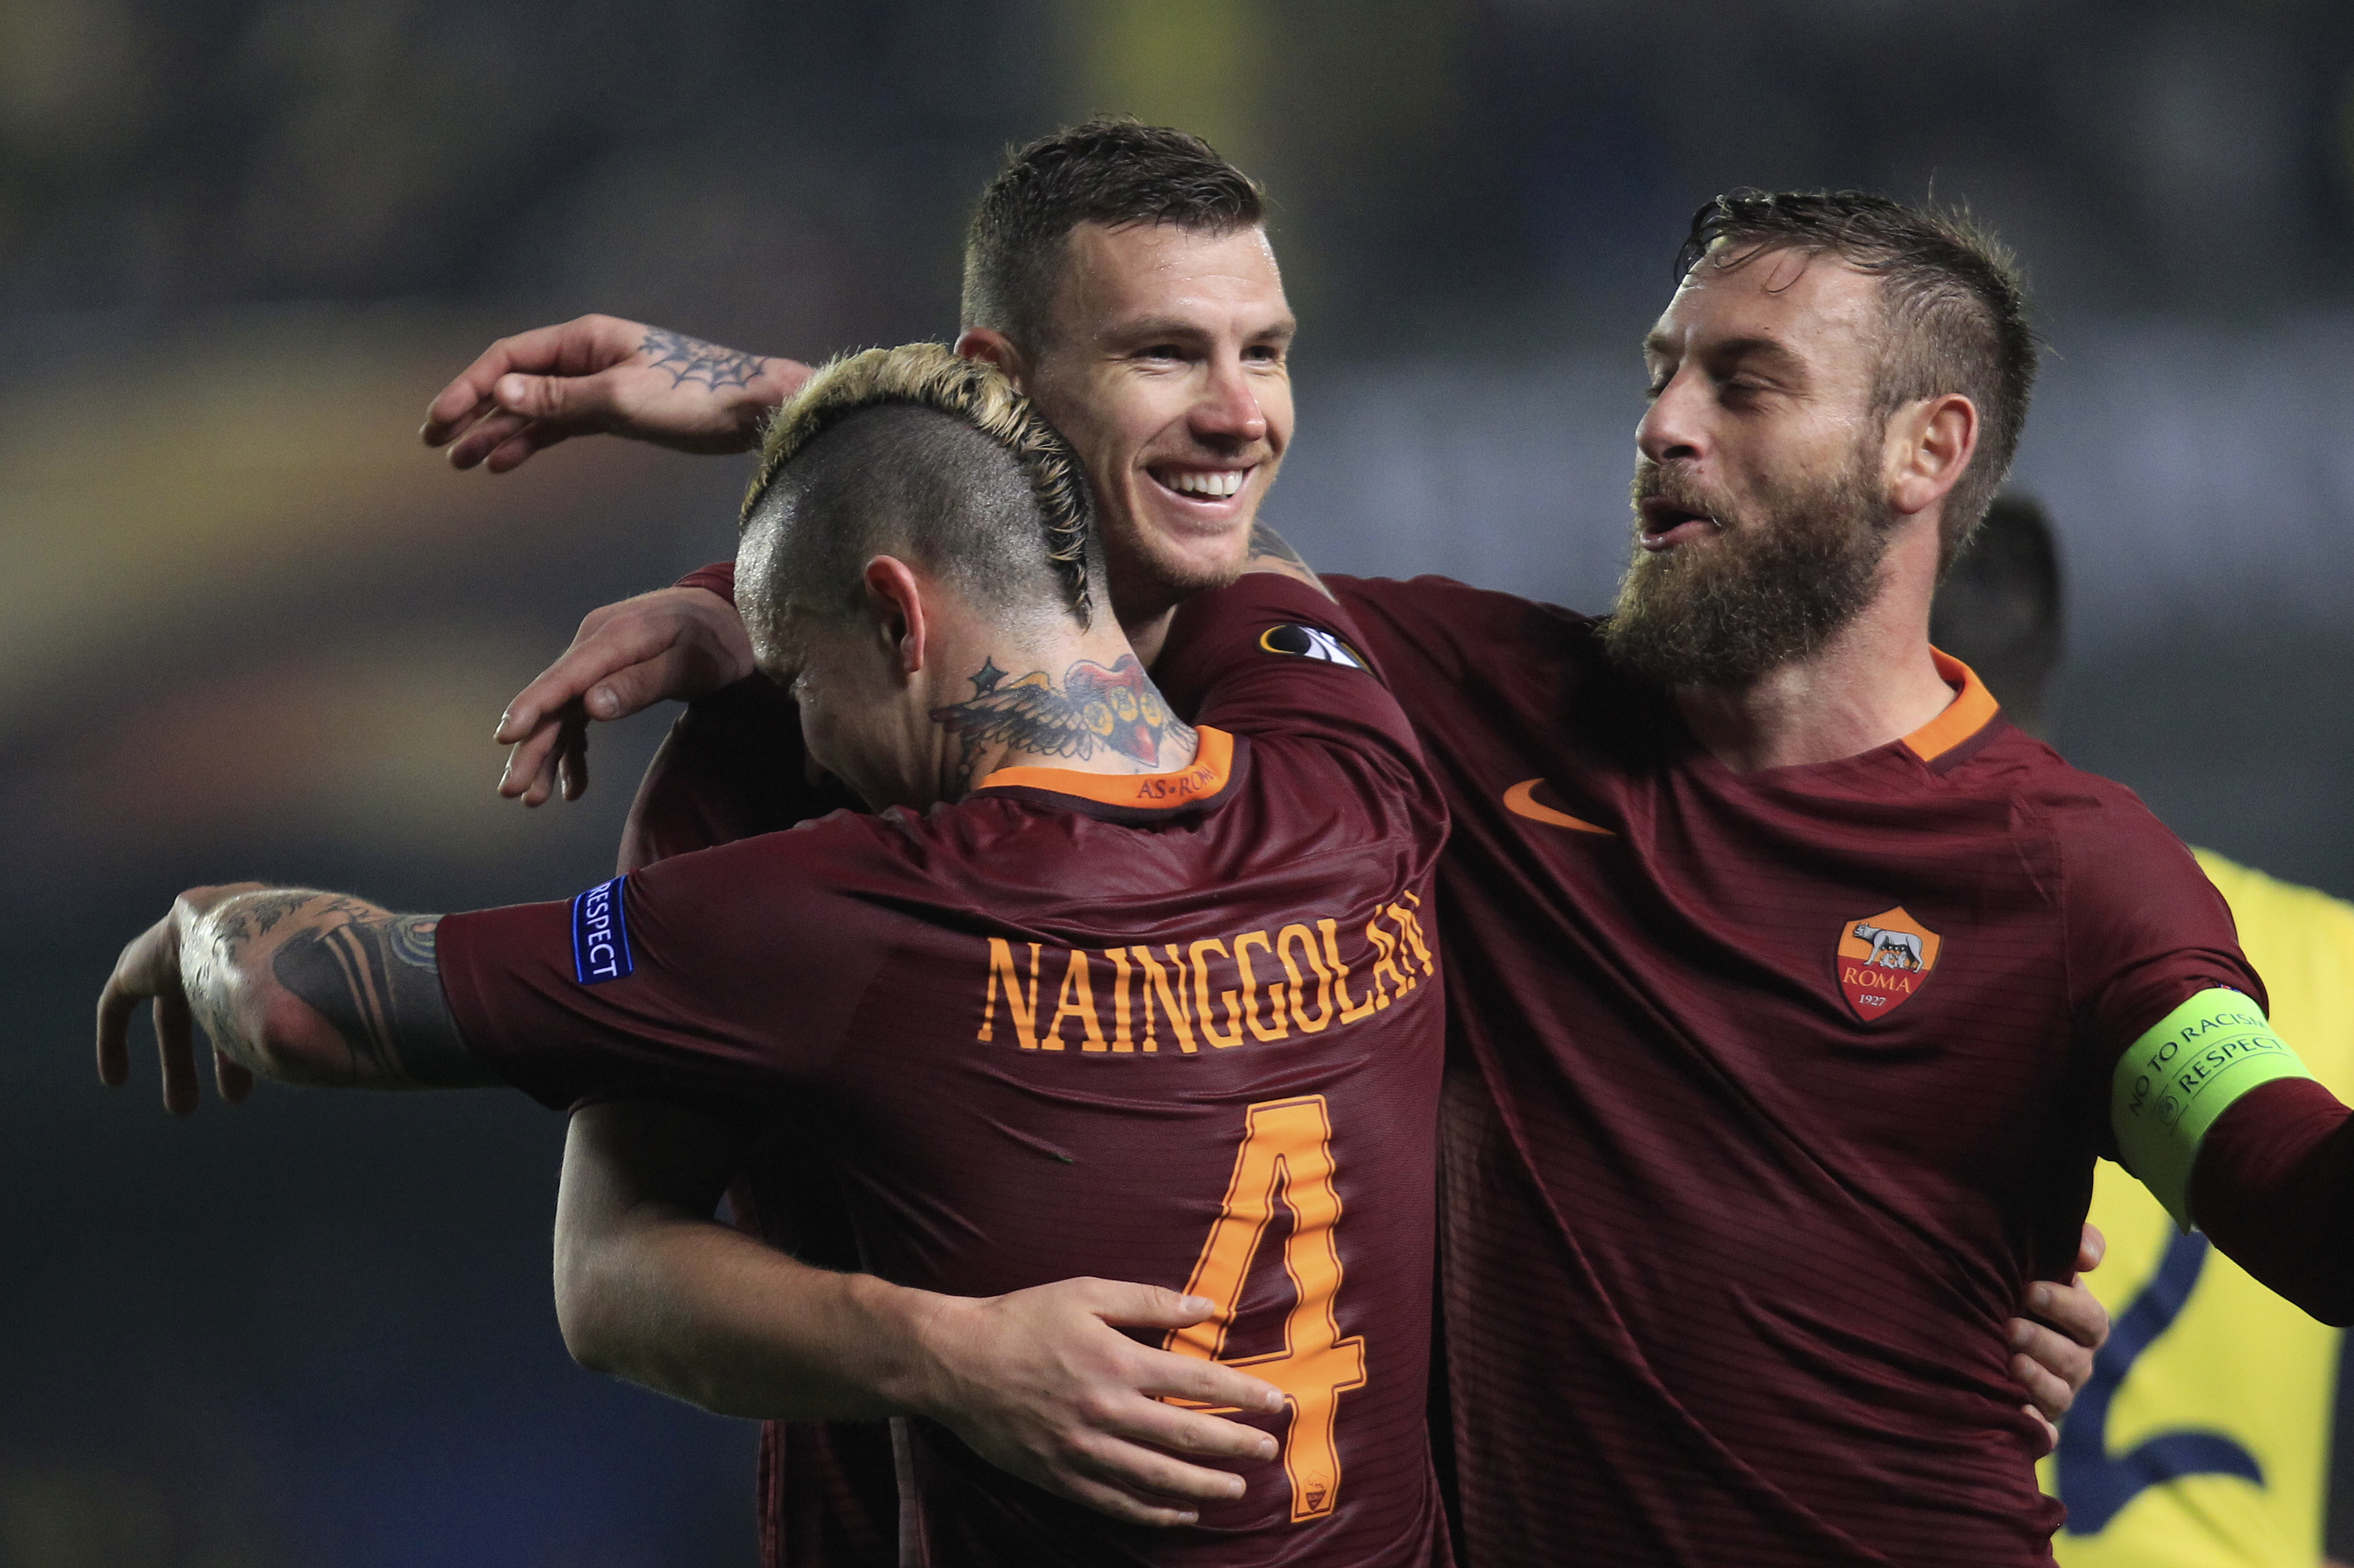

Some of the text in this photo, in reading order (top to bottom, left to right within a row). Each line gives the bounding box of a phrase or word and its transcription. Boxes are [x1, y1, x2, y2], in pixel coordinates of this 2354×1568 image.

[1137, 766, 1214, 799] AS ROM
[585, 881, 618, 977] RESPECT
[977, 889, 1435, 1054] NAINGGOLAN
[1842, 967, 1911, 994] ROMA
[1859, 994, 1887, 1007] 1927
[2129, 1013, 2271, 1118] NO TO RACISM
[2178, 1037, 2283, 1094] RESPECT
[1155, 1094, 1367, 1523] 4
